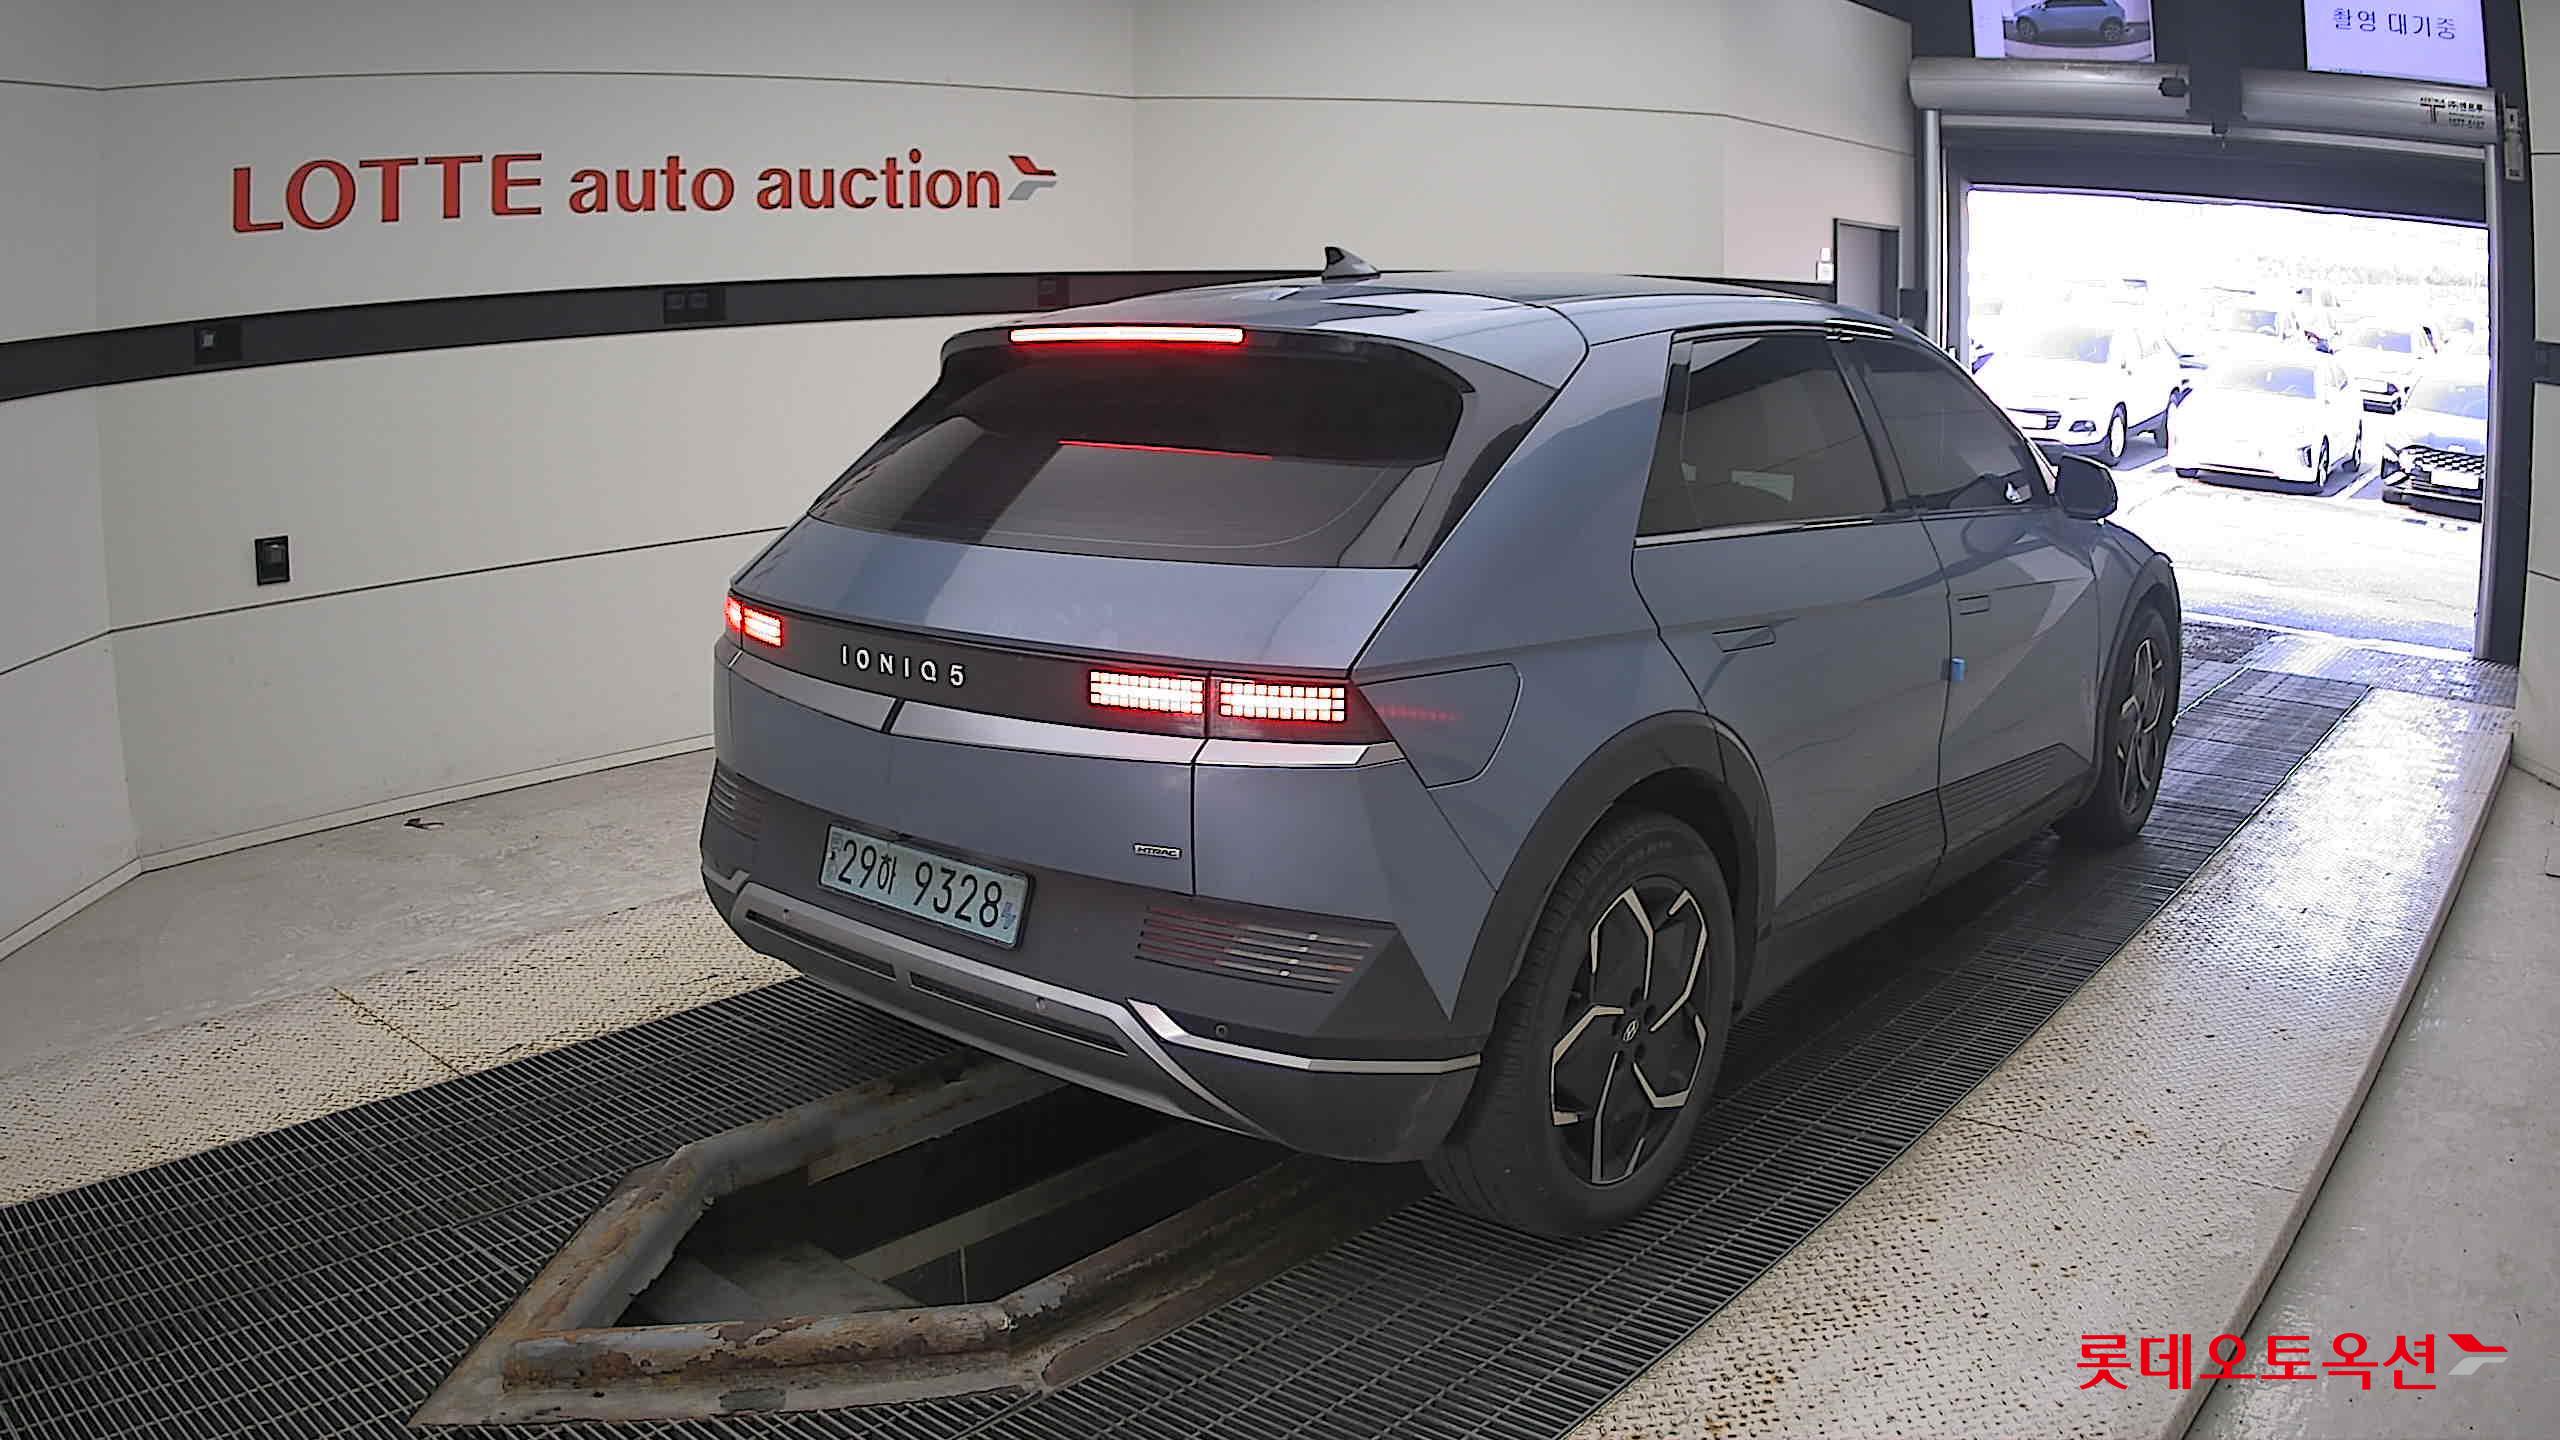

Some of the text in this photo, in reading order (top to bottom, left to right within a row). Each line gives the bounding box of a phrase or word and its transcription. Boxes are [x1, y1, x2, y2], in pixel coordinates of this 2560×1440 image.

[2334, 7, 2457, 41] 촬영 대기중
[232, 148, 1002, 234] LOTTE auto auction
[841, 645, 965, 687] IONIQ 5
[837, 839, 1003, 928] 29하 9328
